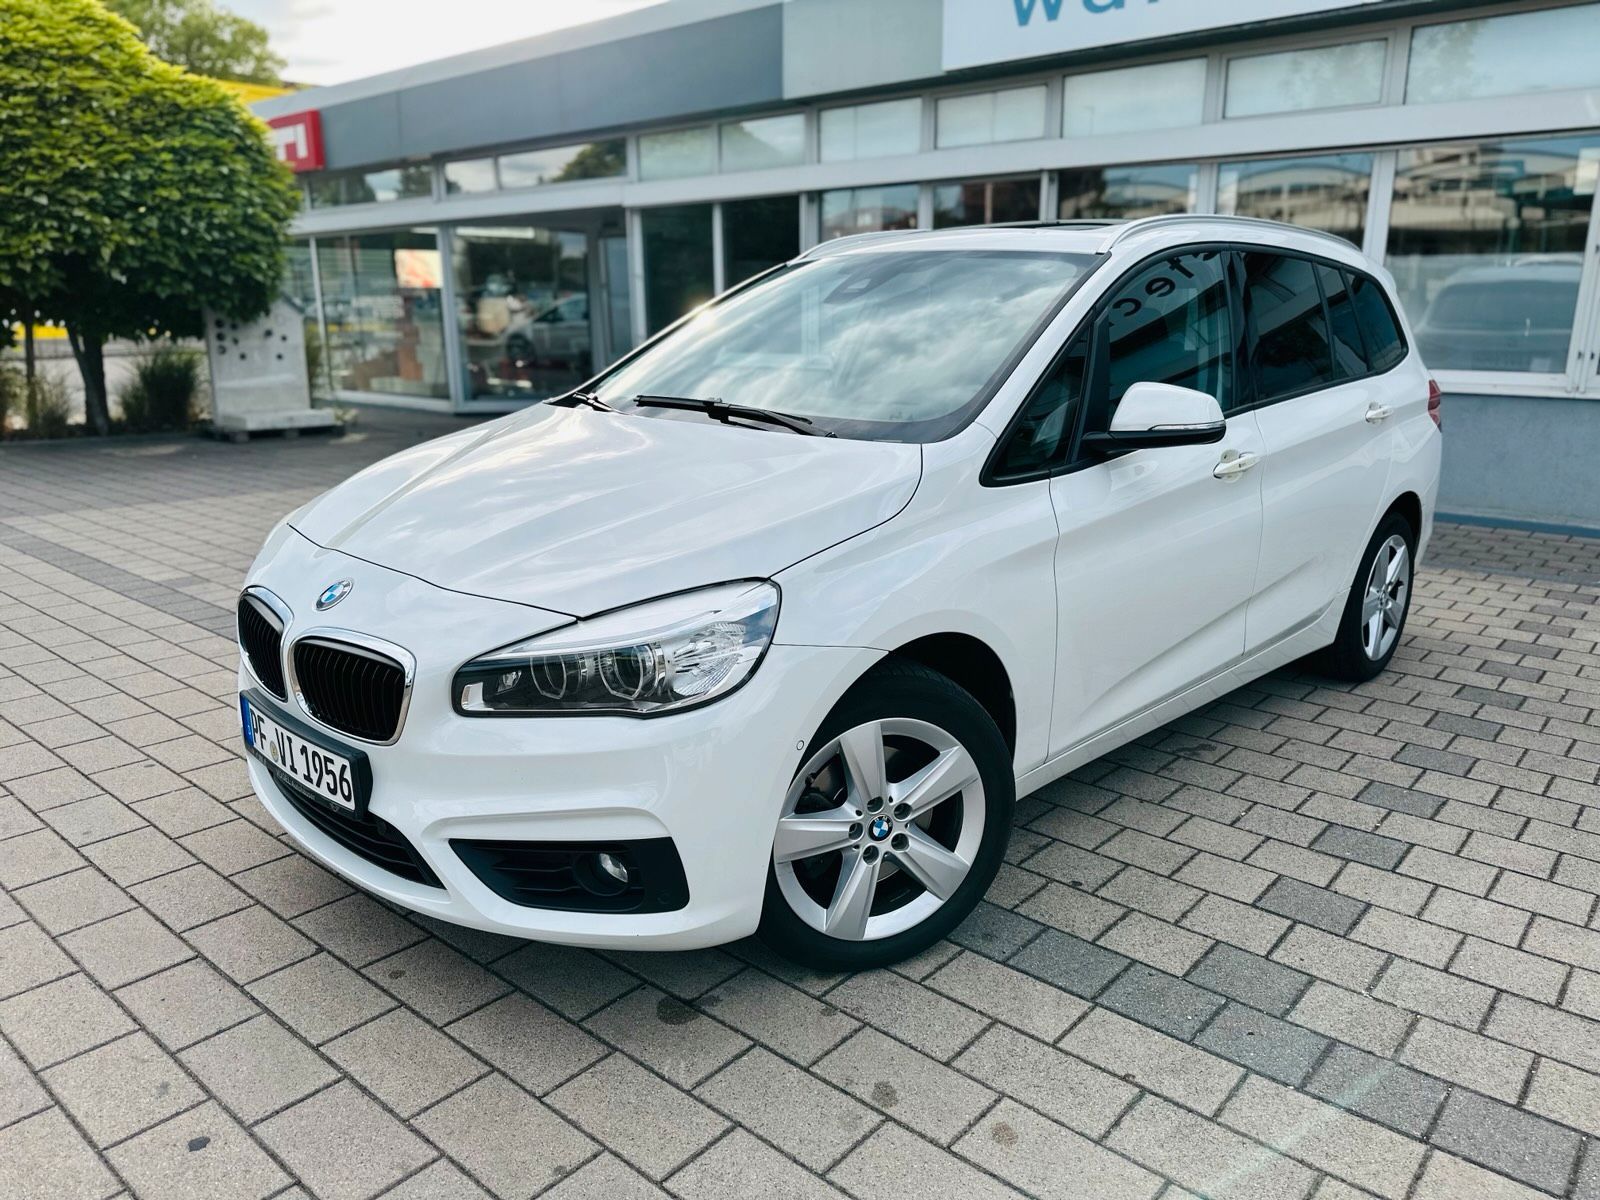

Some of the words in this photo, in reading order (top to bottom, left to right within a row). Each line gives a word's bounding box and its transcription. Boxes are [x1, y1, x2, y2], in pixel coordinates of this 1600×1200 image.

[249, 707, 267, 750] PF
[274, 727, 298, 775] VI
[300, 744, 352, 802] 1956
